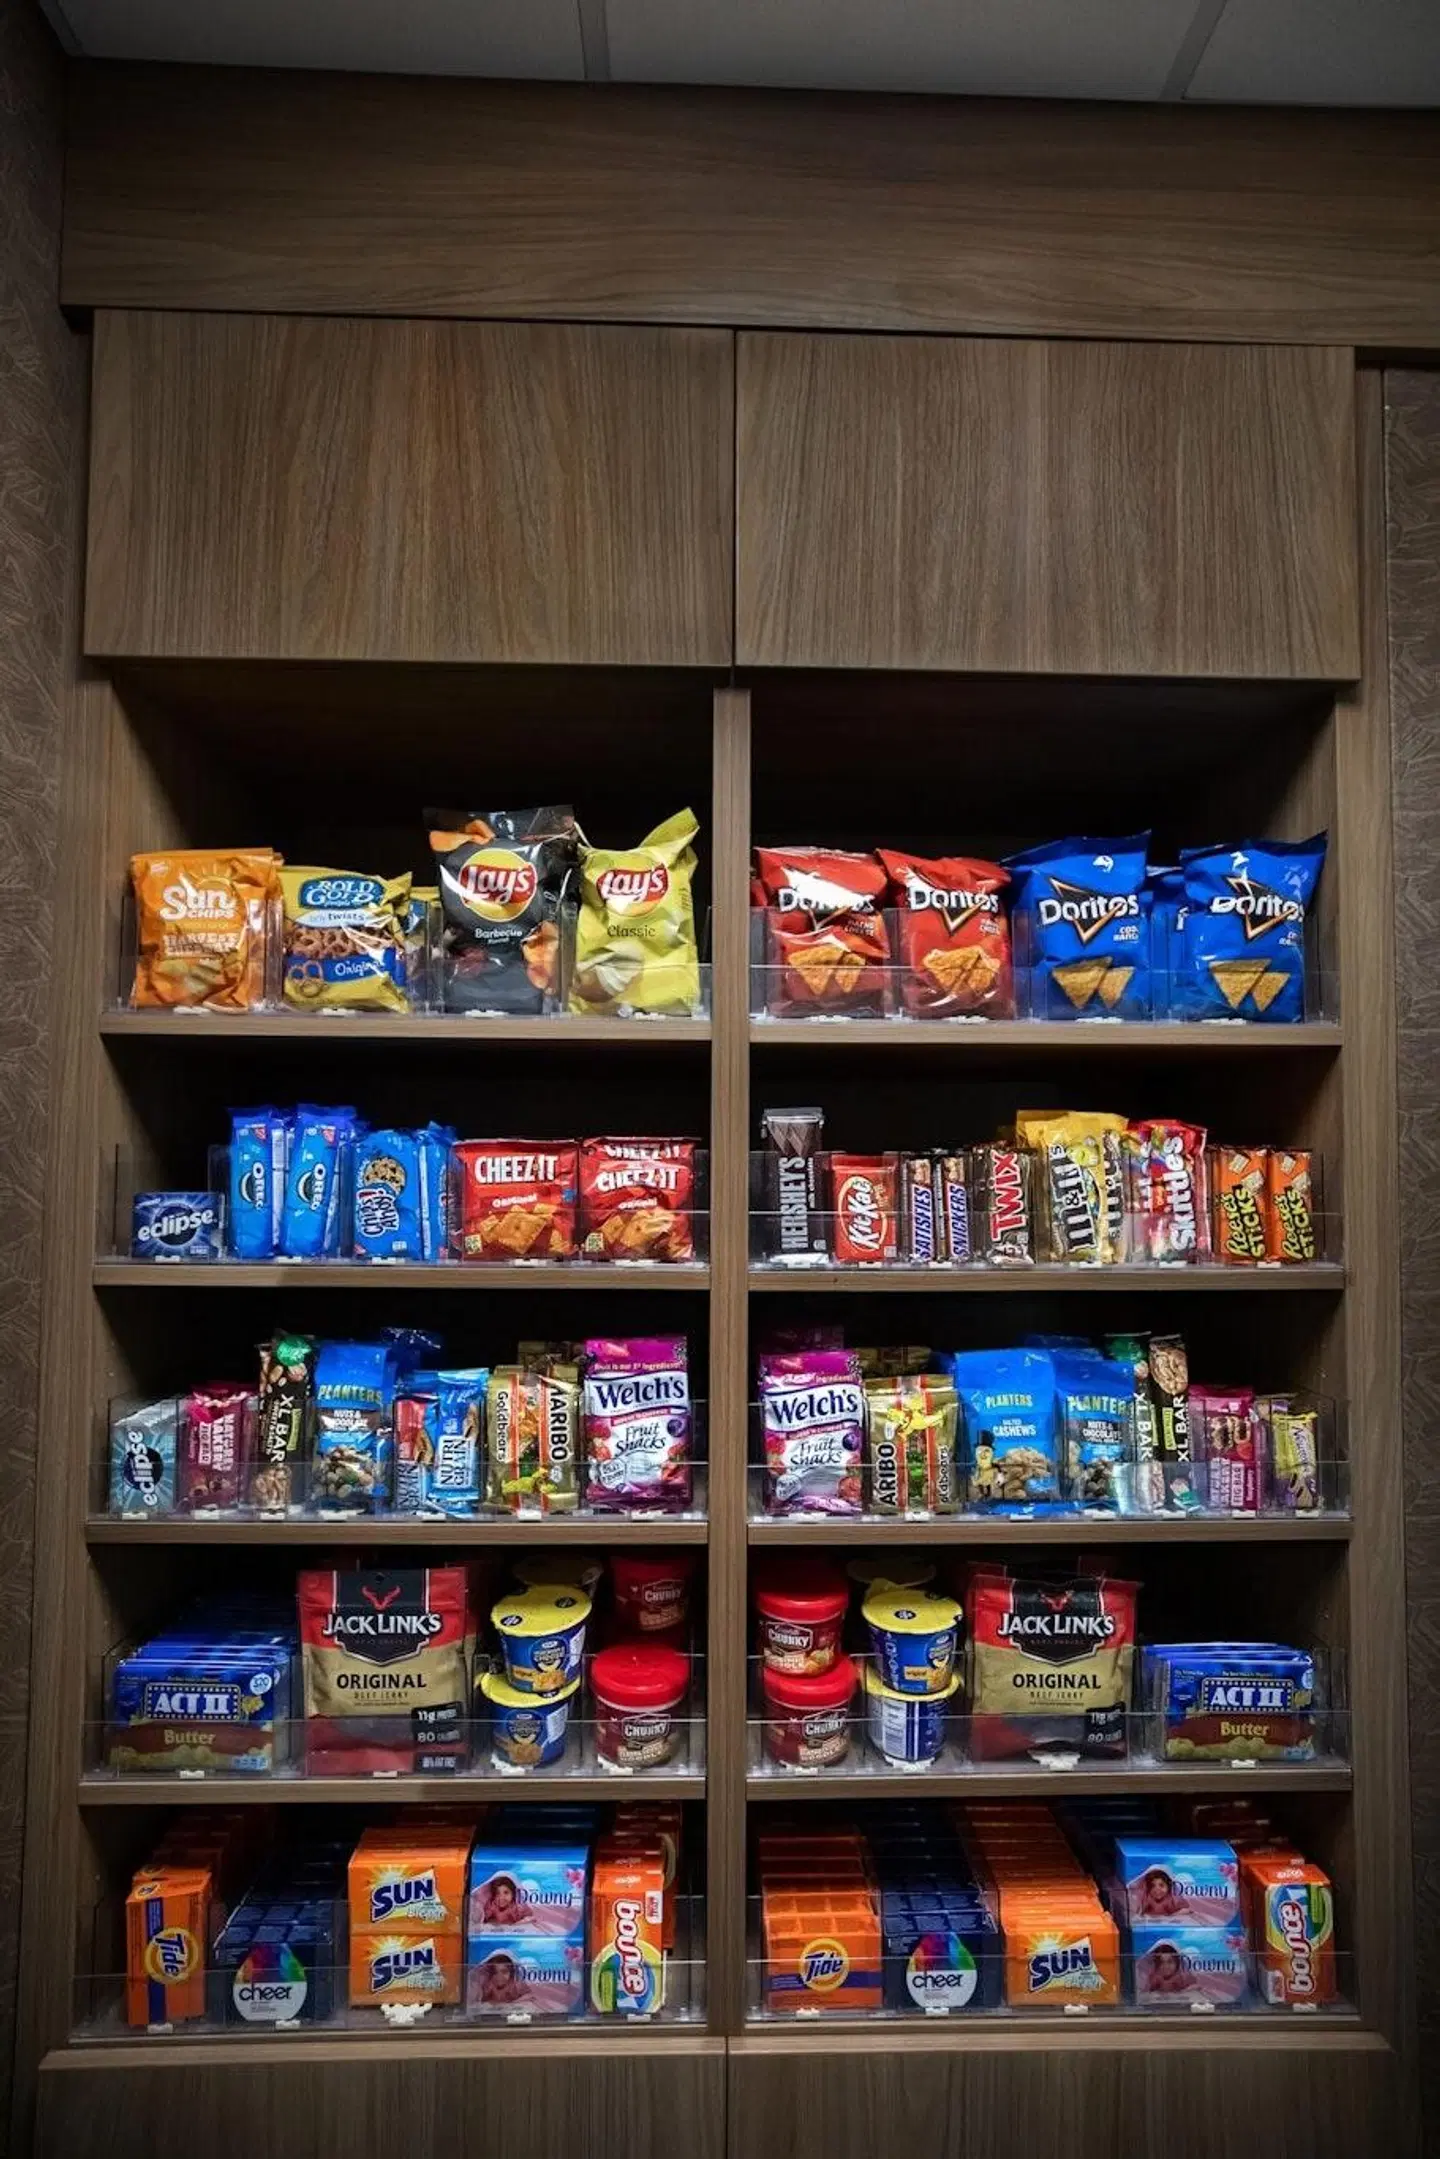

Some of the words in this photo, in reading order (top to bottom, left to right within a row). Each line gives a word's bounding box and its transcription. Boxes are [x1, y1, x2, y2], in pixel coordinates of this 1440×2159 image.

[306, 888, 374, 905] GOLD
[466, 865, 531, 904] Lay's
[600, 868, 665, 902] Lay's
[160, 885, 228, 920] Sun
[909, 886, 998, 913] Doritos
[1039, 894, 1140, 925] Doritos
[328, 912, 365, 922] twists
[475, 927, 523, 939] Barbecue
[607, 924, 656, 938] Classic
[778, 1156, 809, 1250] HERSHEY'S
[990, 1150, 1025, 1240] TWIX
[1163, 1136, 1196, 1250] Skittles
[137, 1208, 214, 1242] eclipse
[912, 1186, 935, 1262] SATISFIES
[948, 1184, 968, 1257] SNICKERS
[317, 1384, 382, 1402] PLANTERS
[594, 1376, 685, 1409] Welch's
[985, 1393, 1033, 1409] PLANTERS
[278, 1394, 294, 1418] XL
[770, 1389, 858, 1424] Welch's
[1067, 1395, 1127, 1416] PLANTER
[1132, 1392, 1147, 1418] XL
[1173, 1395, 1187, 1433] BAR
[496, 1390, 509, 1462] Goldbears
[625, 1422, 660, 1444] Fruit
[993, 1424, 1037, 1437] CASHEWS
[271, 1424, 289, 1463] BAR
[615, 1437, 667, 1457] Snacks
[799, 1438, 834, 1456] Fruit
[1177, 1438, 1189, 1462] XL
[128, 1430, 158, 1506] eclipse
[440, 1439, 454, 1486] NUTRI
[453, 1438, 466, 1486] GRAIN
[789, 1451, 842, 1471] Snacks
[878, 1443, 896, 1506] ARIBO
[937, 1446, 948, 1503] oldbears
[1233, 1467, 1242, 1486] BAR
[1233, 1488, 1242, 1504] FIG
[322, 1613, 378, 1636] JACK
[377, 1613, 442, 1636] LINK'S
[998, 1613, 1051, 1636] JACK
[1053, 1613, 1115, 1636] LINK'S
[768, 1628, 810, 1648] CHUNKY
[336, 1673, 428, 1690] ORIGINAL
[1012, 1674, 1102, 1690] ORIGINAL
[155, 1693, 200, 1714] ACT
[203, 1693, 230, 1714] II
[1210, 1687, 1256, 1706] ACT
[1257, 1688, 1284, 1706] II
[163, 1729, 216, 1745] Butter
[625, 1722, 667, 1737] CHUNKY
[1220, 1721, 1270, 1736] Butter
[373, 1879, 433, 1919] SUN
[517, 1886, 573, 1908] Downy
[1171, 1880, 1228, 1899] Downy
[154, 1932, 188, 1977] Tide
[613, 1899, 648, 1996] bounce
[1282, 1901, 1315, 1993] bounce
[373, 1948, 433, 1989] SUN
[515, 1963, 571, 1984] Downy
[804, 1951, 844, 1982] Tide
[1031, 1947, 1091, 1988] SUN
[1179, 1954, 1236, 1975] Downy
[912, 1973, 965, 1988] cheer
[239, 1985, 292, 2001] cheer
